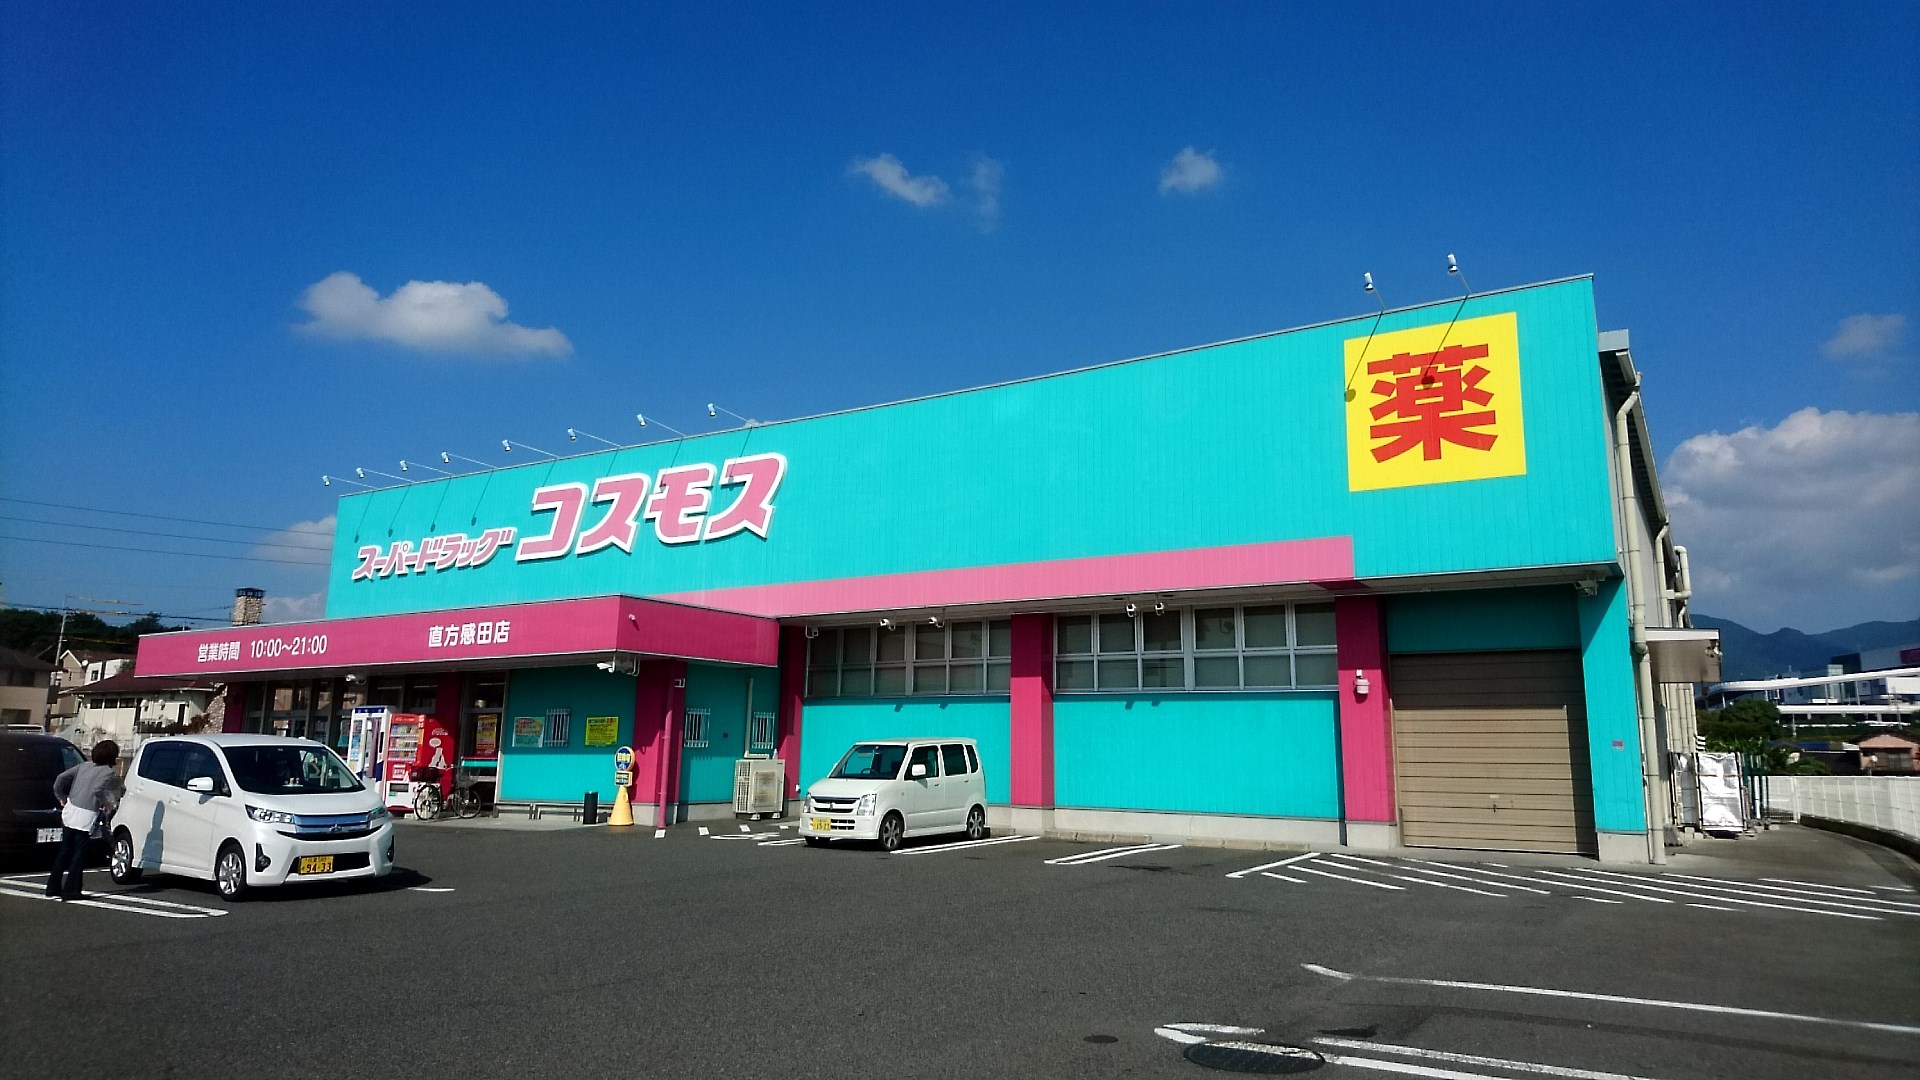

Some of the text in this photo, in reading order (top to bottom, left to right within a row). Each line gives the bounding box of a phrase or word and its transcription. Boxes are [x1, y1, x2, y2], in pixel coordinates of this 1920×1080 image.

[1367, 343, 1499, 463] 薬
[351, 451, 788, 582] スーパードラッグ コスモス
[197, 641, 241, 663] 営業時間
[428, 619, 511, 648] 直方感田店
